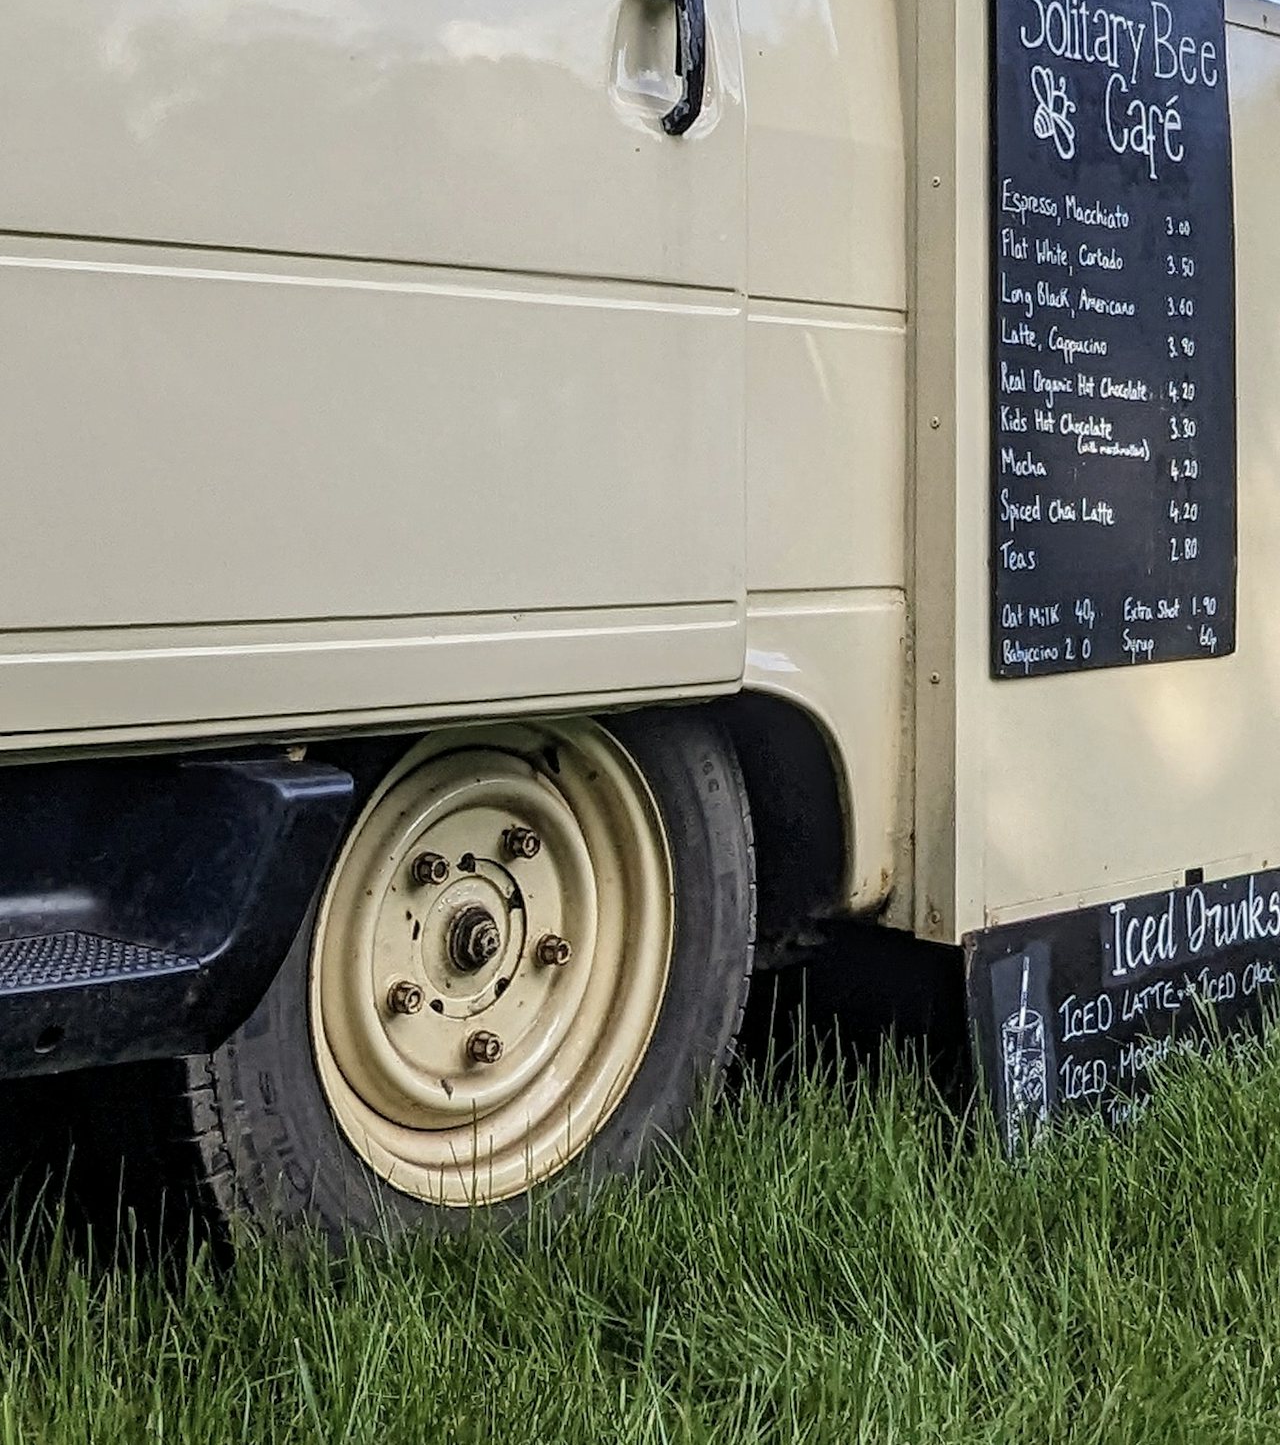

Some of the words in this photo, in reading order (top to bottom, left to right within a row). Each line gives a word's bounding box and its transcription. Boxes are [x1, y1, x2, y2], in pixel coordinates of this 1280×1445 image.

[1151, 1, 1218, 87] Bee
[1105, 72, 1185, 180] Café
[1002, 178, 1061, 226] Espresso,
[1065, 194, 1130, 229] Macchiato
[1002, 228, 1028, 260] Flat
[1079, 243, 1124, 270] Cortado
[1166, 255, 1195, 277] 3.50
[1002, 272, 1033, 319] Long
[1079, 287, 1136, 316] Americano
[1167, 296, 1194, 317] 3.60
[1002, 317, 1042, 352] Latte,
[1001, 361, 1027, 394] Real
[1033, 369, 1073, 409] Organic
[1077, 373, 1096, 398] Hot
[1100, 377, 1148, 402] Chocolate
[1168, 381, 1196, 403] 4.20
[1001, 405, 1028, 432] Kids
[1034, 409, 1056, 433] Hot
[1060, 413, 1113, 441] Chocolate
[1169, 416, 1197, 440] 3.30
[1001, 447, 1048, 476] Mocha
[1170, 459, 1199, 482] 4.20
[1000, 488, 1041, 532] Spiced
[1048, 499, 1076, 525] Chai
[1082, 497, 1115, 526] Latte
[1169, 501, 1199, 525] 4.20
[1000, 539, 1036, 571] Teas
[1170, 537, 1198, 562] 2.80
[1002, 603, 1023, 628] Oat
[1124, 596, 1154, 622] Extra
[1157, 598, 1180, 620] Shot
[1003, 639, 1059, 674] Babyccino
[1122, 628, 1154, 665] Syrup
[1110, 892, 1177, 976] Iced
[1058, 994, 1113, 1042] ICED
[1121, 981, 1181, 1022] LATTE
[1197, 966, 1237, 1004] ICED
[1059, 1054, 1108, 1100] ICED
